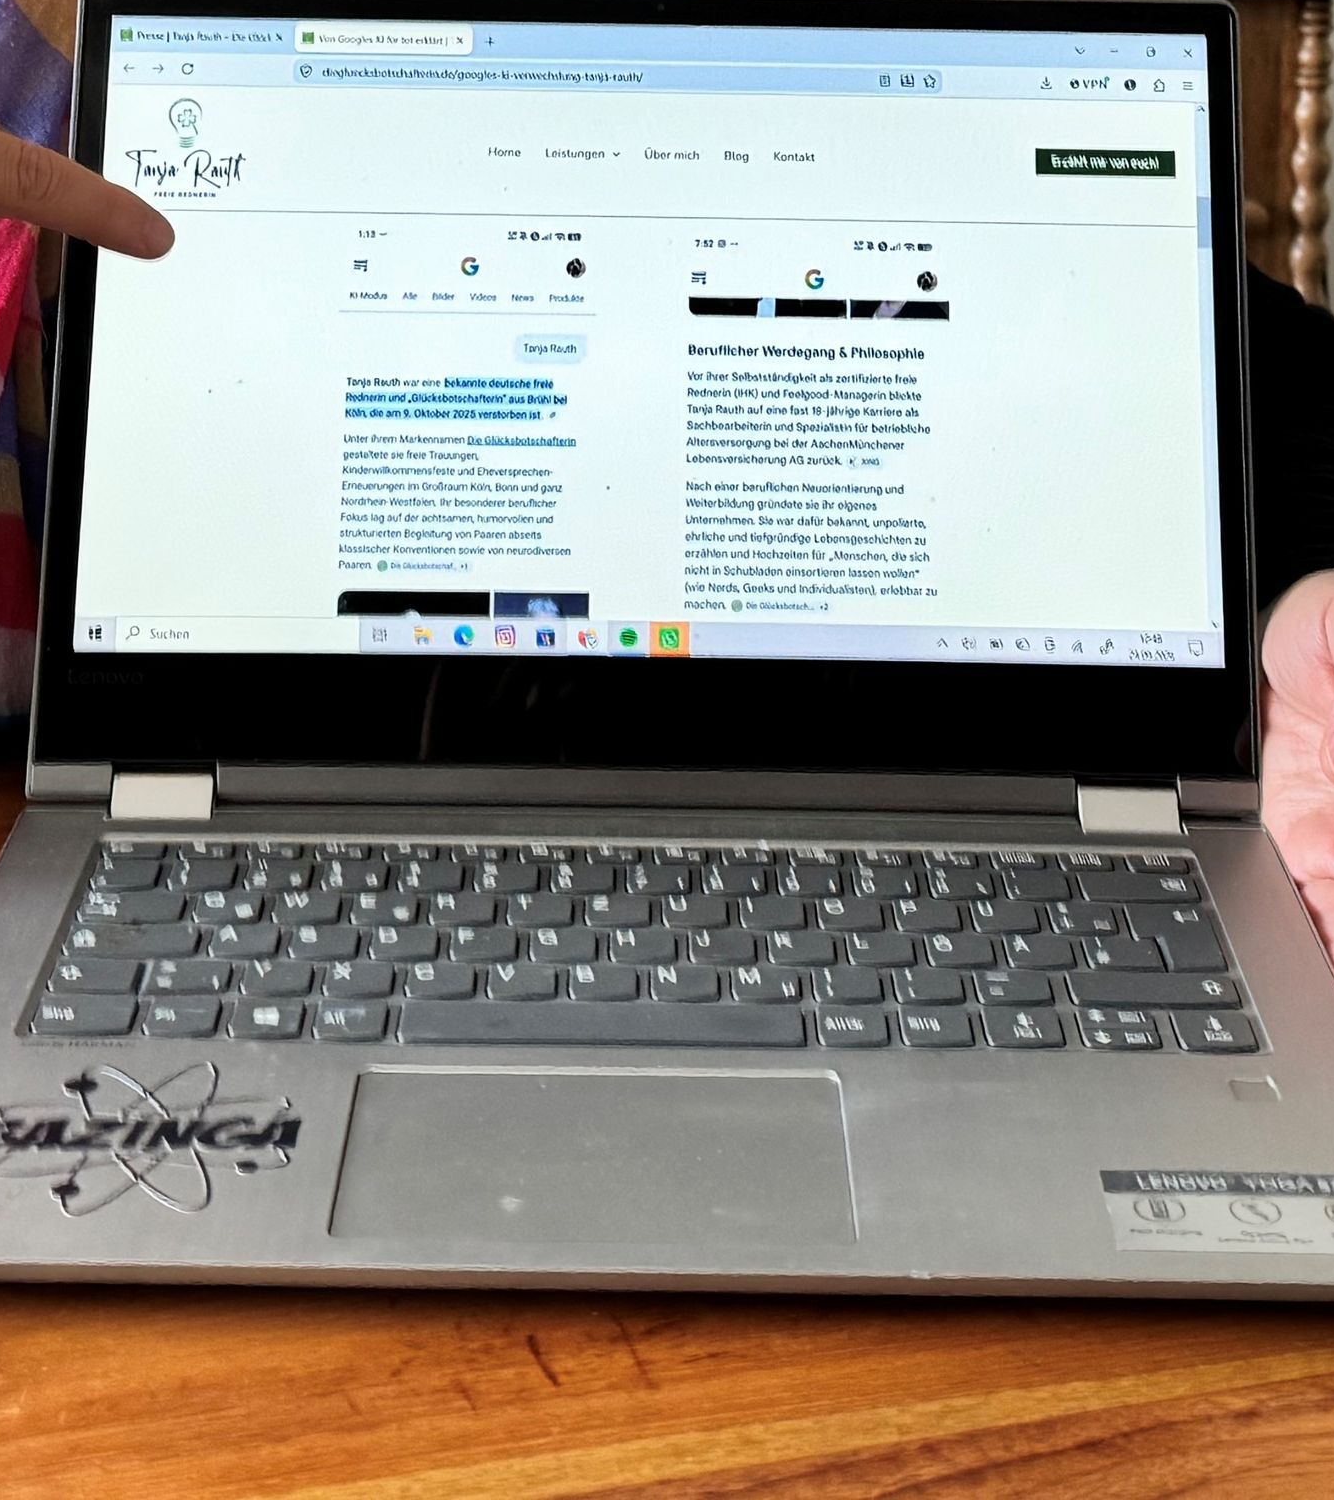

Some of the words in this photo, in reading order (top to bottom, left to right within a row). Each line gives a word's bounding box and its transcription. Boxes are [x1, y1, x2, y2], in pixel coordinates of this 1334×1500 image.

[488, 147, 522, 158] Home
[545, 148, 606, 160] Leistungen
[644, 147, 672, 160] Über
[674, 148, 700, 160] mich
[724, 151, 749, 163] Blog
[774, 151, 816, 162] Kontakt
[694, 239, 714, 248] 7:52
[524, 343, 548, 355] Tanja
[347, 377, 371, 390] Tanja
[374, 377, 400, 387] Rauth
[404, 379, 419, 388] war
[422, 378, 440, 388] eine
[445, 378, 487, 388] bekannte
[489, 379, 531, 389] deutsche
[534, 379, 553, 389] freie
[346, 392, 386, 402] Rednerin
[389, 392, 406, 402] und
[509, 395, 525, 404] aus
[527, 394, 551, 404] Brühl
[554, 394, 567, 404] bei
[370, 408, 383, 418] die
[386, 410, 401, 418] am
[414, 409, 450, 419] Oktober
[478, 409, 527, 419] verstorben
[344, 434, 368, 444] Unter
[371, 434, 397, 444] ihrem
[400, 434, 465, 444] Markennamen
[467, 435, 483, 445] Die
[483, 435, 576, 445] Glücksbotschafterin
[343, 449, 388, 462] gestaltete
[391, 449, 404, 459] sie
[407, 450, 426, 460] freie
[458, 466, 474, 476] und
[342, 481, 405, 493] Erneuerungen
[408, 481, 419, 491] im
[422, 482, 467, 492] Großraum
[496, 482, 518, 492] Bonn
[521, 483, 538, 493] und
[541, 484, 562, 495] ganz
[455, 498, 505, 508] besonderer
[508, 498, 556, 508] beruflicher
[341, 512, 368, 522] Fokus
[371, 512, 384, 525] lag
[387, 513, 402, 523] auf
[405, 513, 418, 523] der
[477, 514, 534, 524] humorvollen
[536, 514, 553, 524] und
[340, 528, 401, 538] strukturierten
[404, 529, 452, 542] Begleitung
[474, 530, 506, 540] Paaren
[509, 530, 541, 540] abseits
[339, 544, 390, 554] klassischer
[393, 545, 455, 555] Konventionen
[459, 545, 485, 555] sowie
[507, 546, 571, 556] neurodiversen
[150, 628, 190, 640] Suchen
